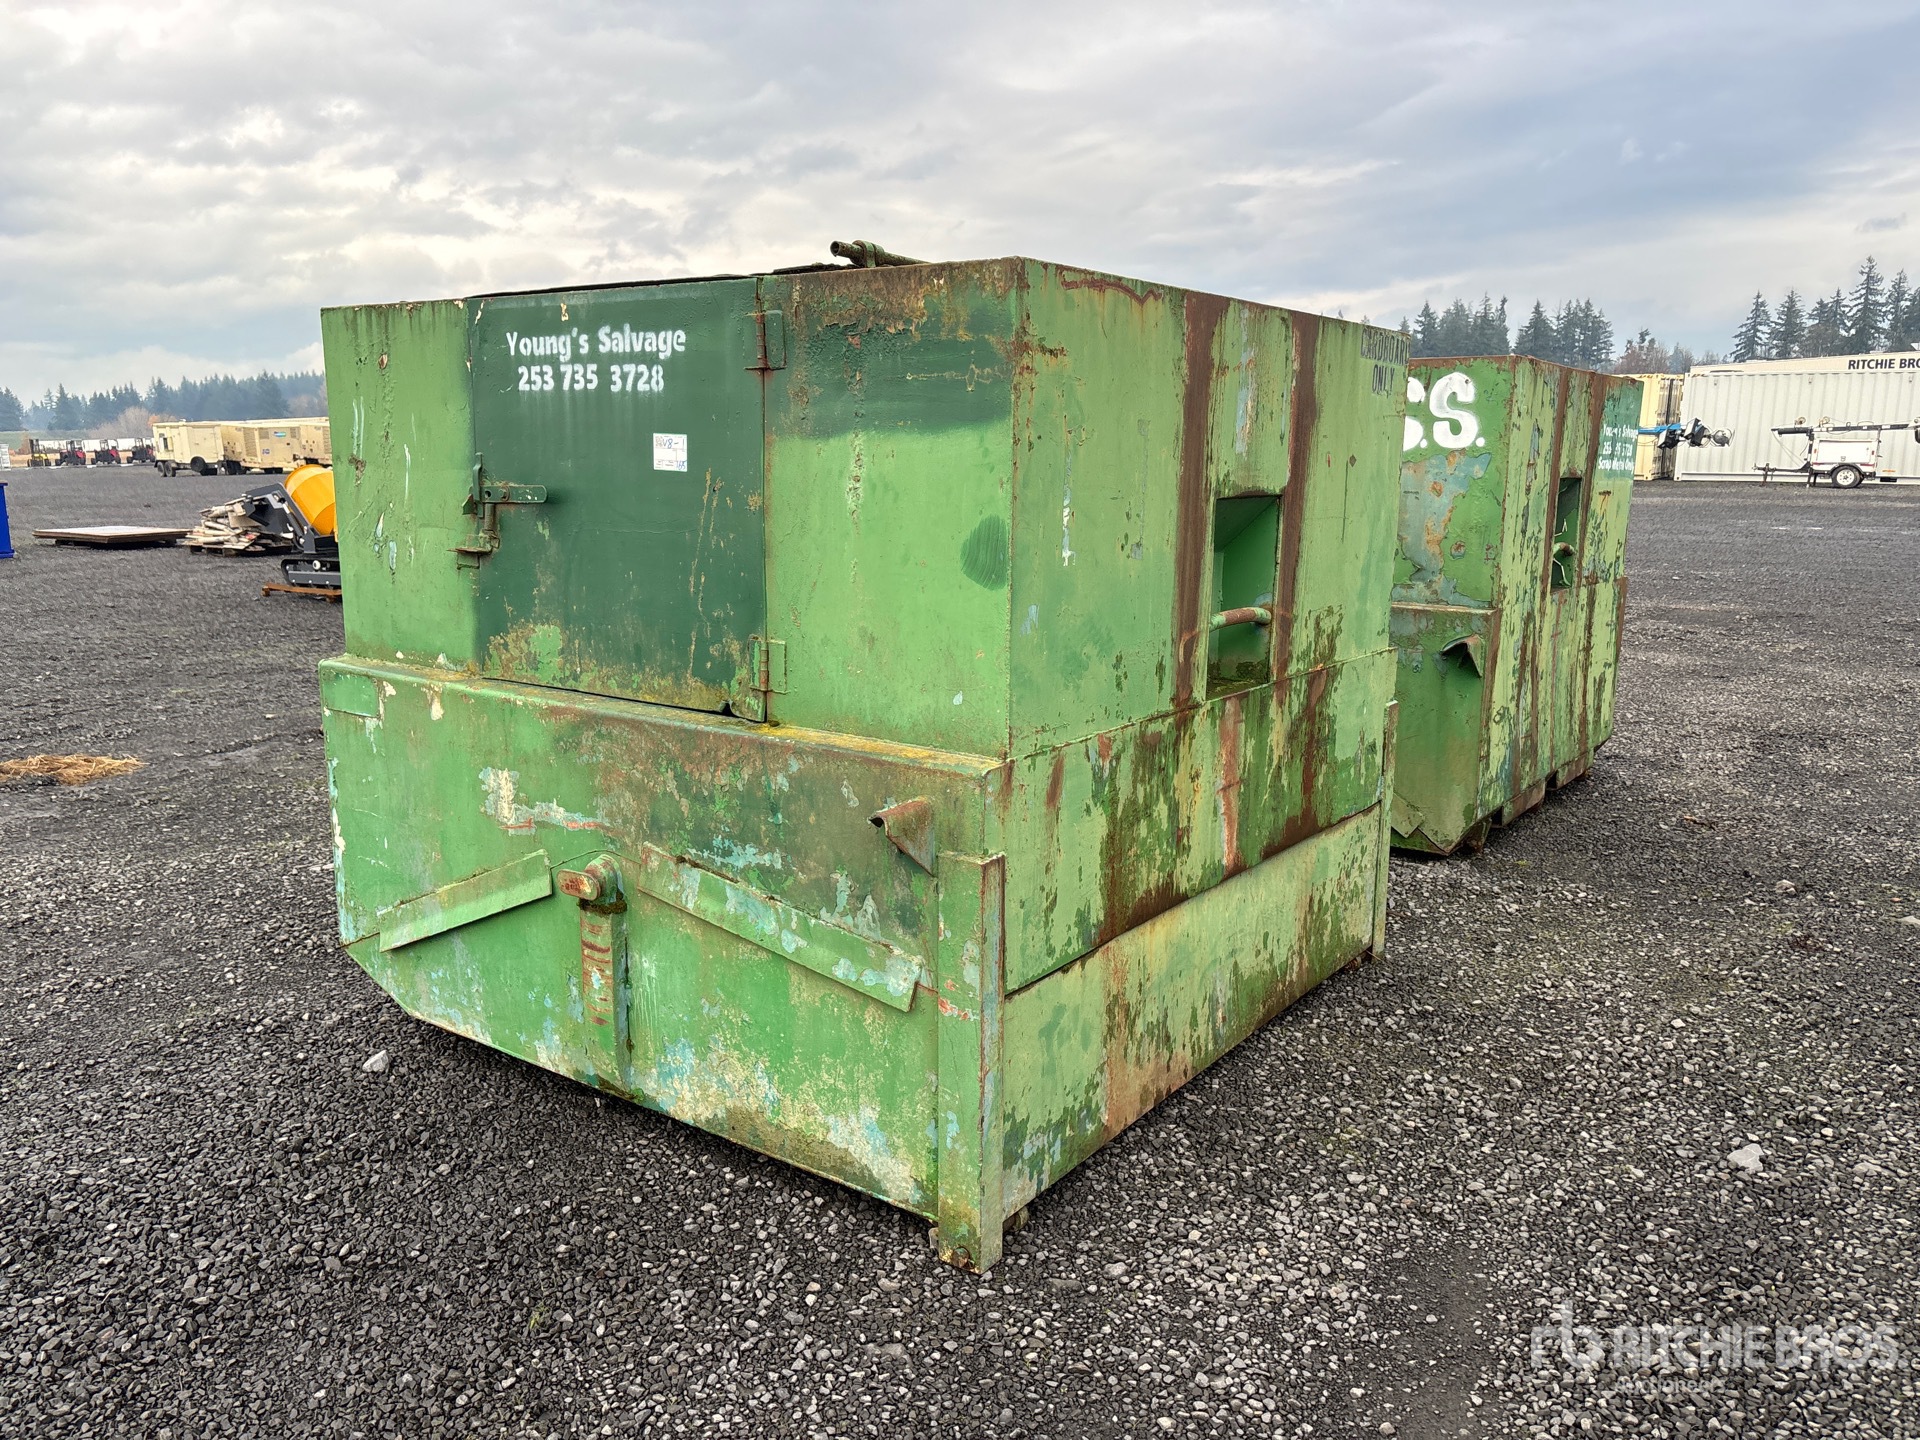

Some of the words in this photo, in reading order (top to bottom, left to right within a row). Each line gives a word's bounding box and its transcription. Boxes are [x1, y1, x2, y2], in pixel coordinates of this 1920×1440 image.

[506, 327, 589, 362] Young's
[598, 323, 686, 360] Salvage
[1361, 328, 1411, 365] CARDBOARD
[518, 365, 555, 391] 253
[560, 363, 599, 391] 735
[610, 363, 665, 392] 3728
[1372, 364, 1395, 396] ONLY
[1848, 358, 1896, 370] RITCHIE
